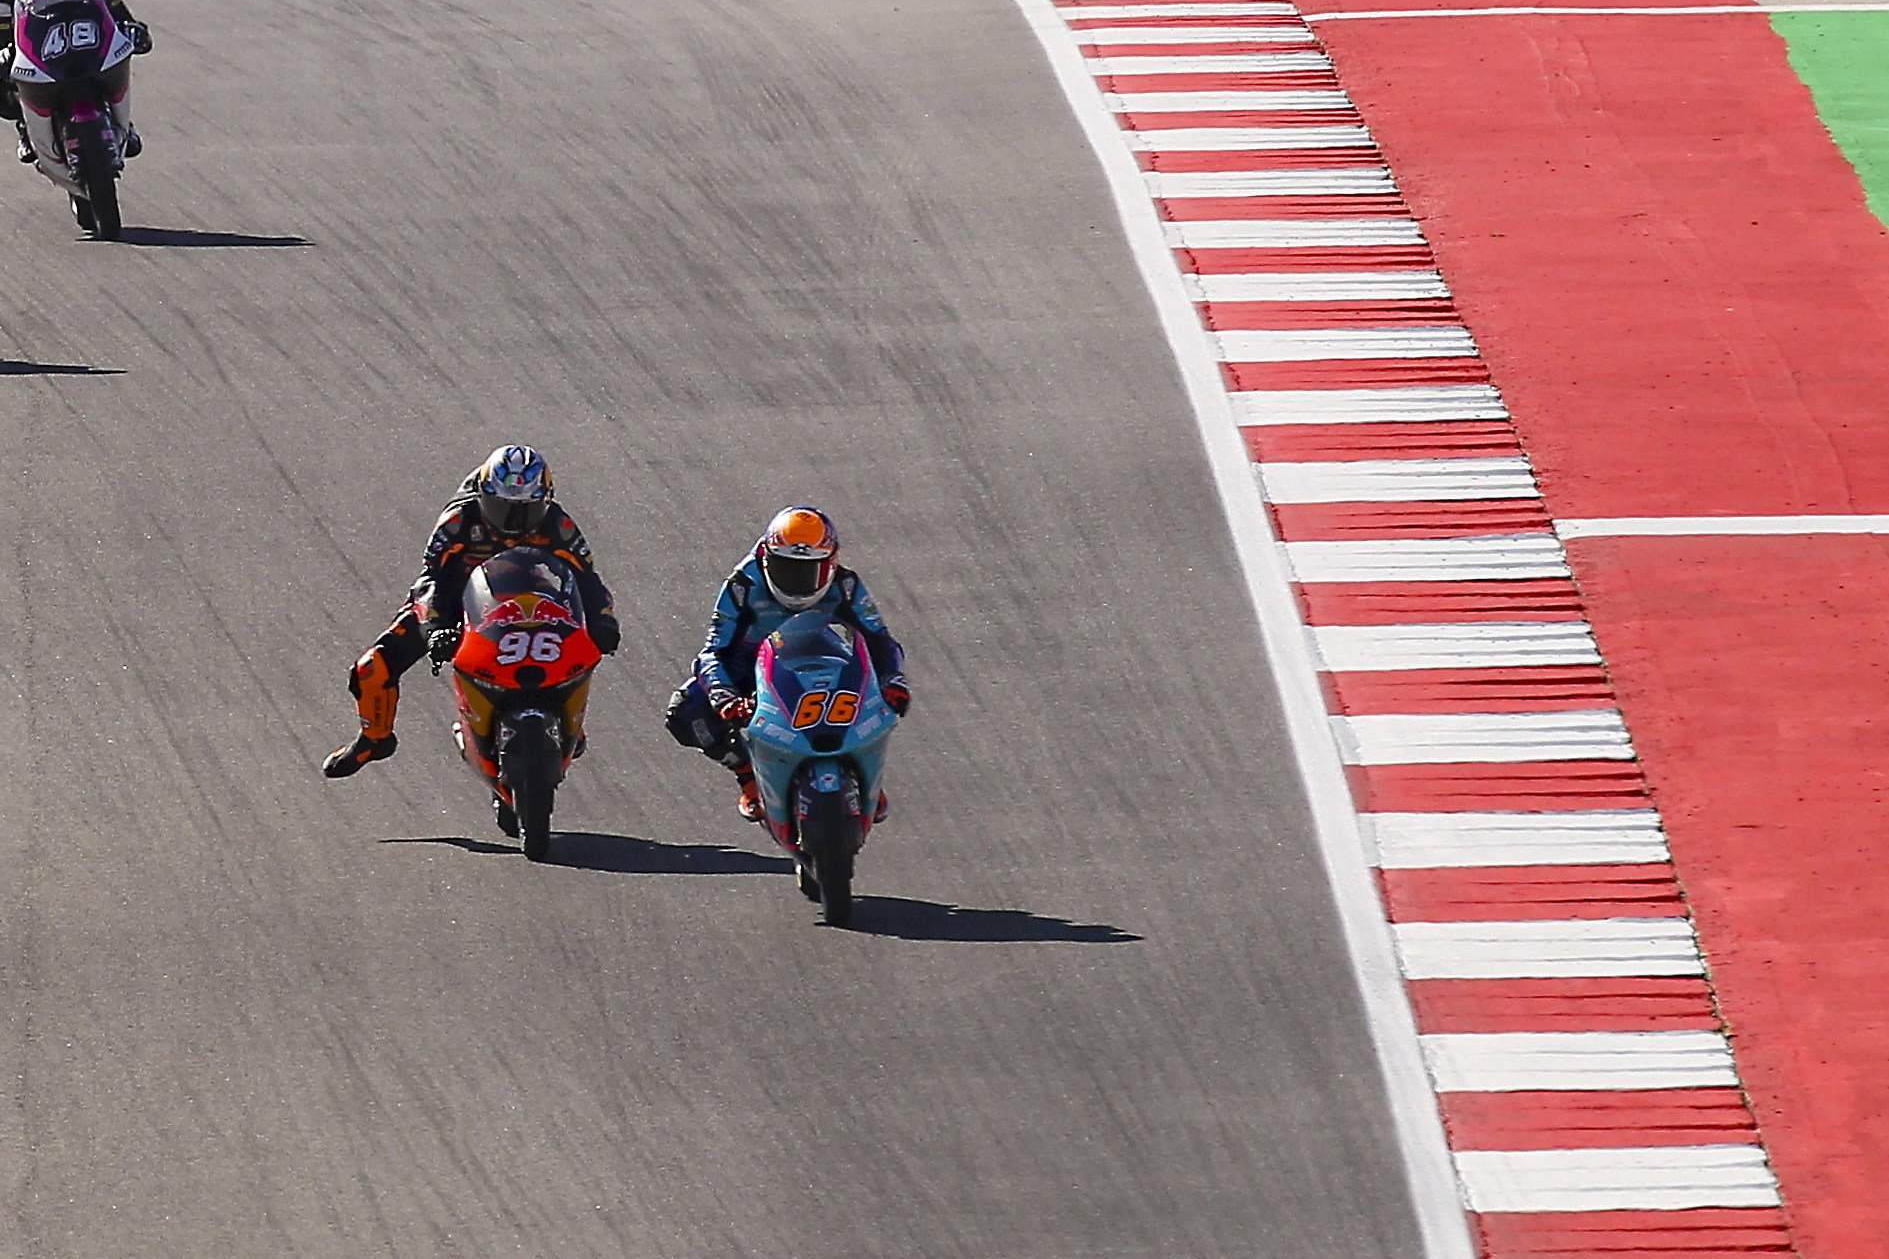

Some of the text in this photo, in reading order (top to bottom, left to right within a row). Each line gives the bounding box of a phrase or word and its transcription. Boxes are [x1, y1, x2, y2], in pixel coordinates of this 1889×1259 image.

[41, 21, 99, 61] 48
[496, 631, 562, 666] 96
[792, 690, 862, 731] 66
